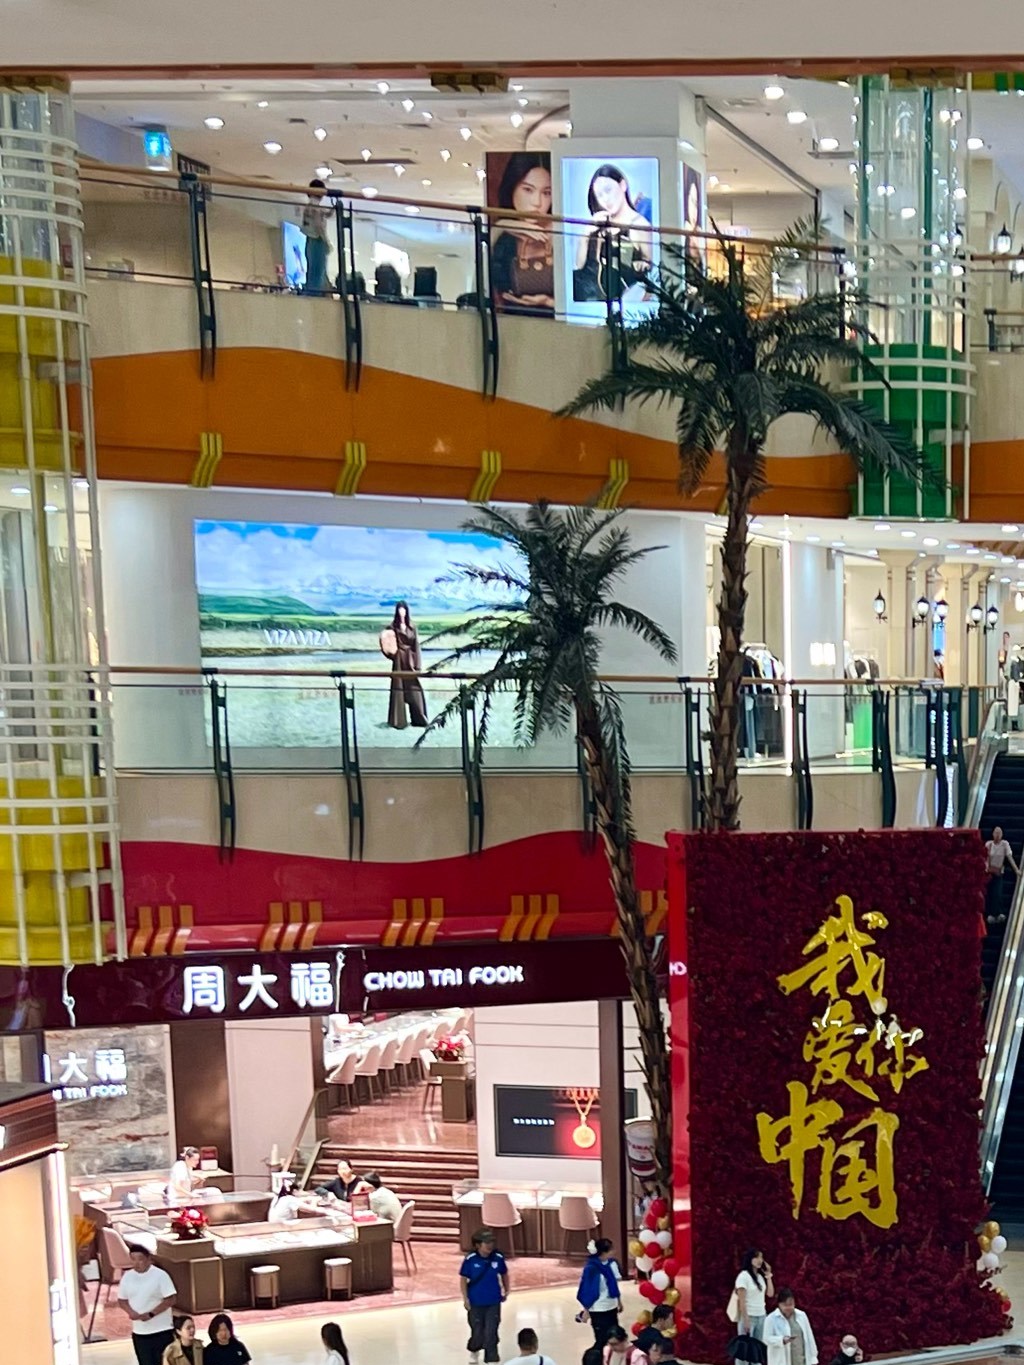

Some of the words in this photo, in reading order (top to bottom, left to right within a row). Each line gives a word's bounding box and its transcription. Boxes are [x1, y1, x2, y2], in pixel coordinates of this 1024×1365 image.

[363, 970, 425, 991] CHOW
[428, 968, 462, 987] TAI
[468, 965, 524, 984] FOOK
[777, 895, 888, 1016] 我
[181, 961, 334, 1014] 周大福
[43, 1048, 128, 1084] 大福
[756, 1081, 901, 1229] 中国
